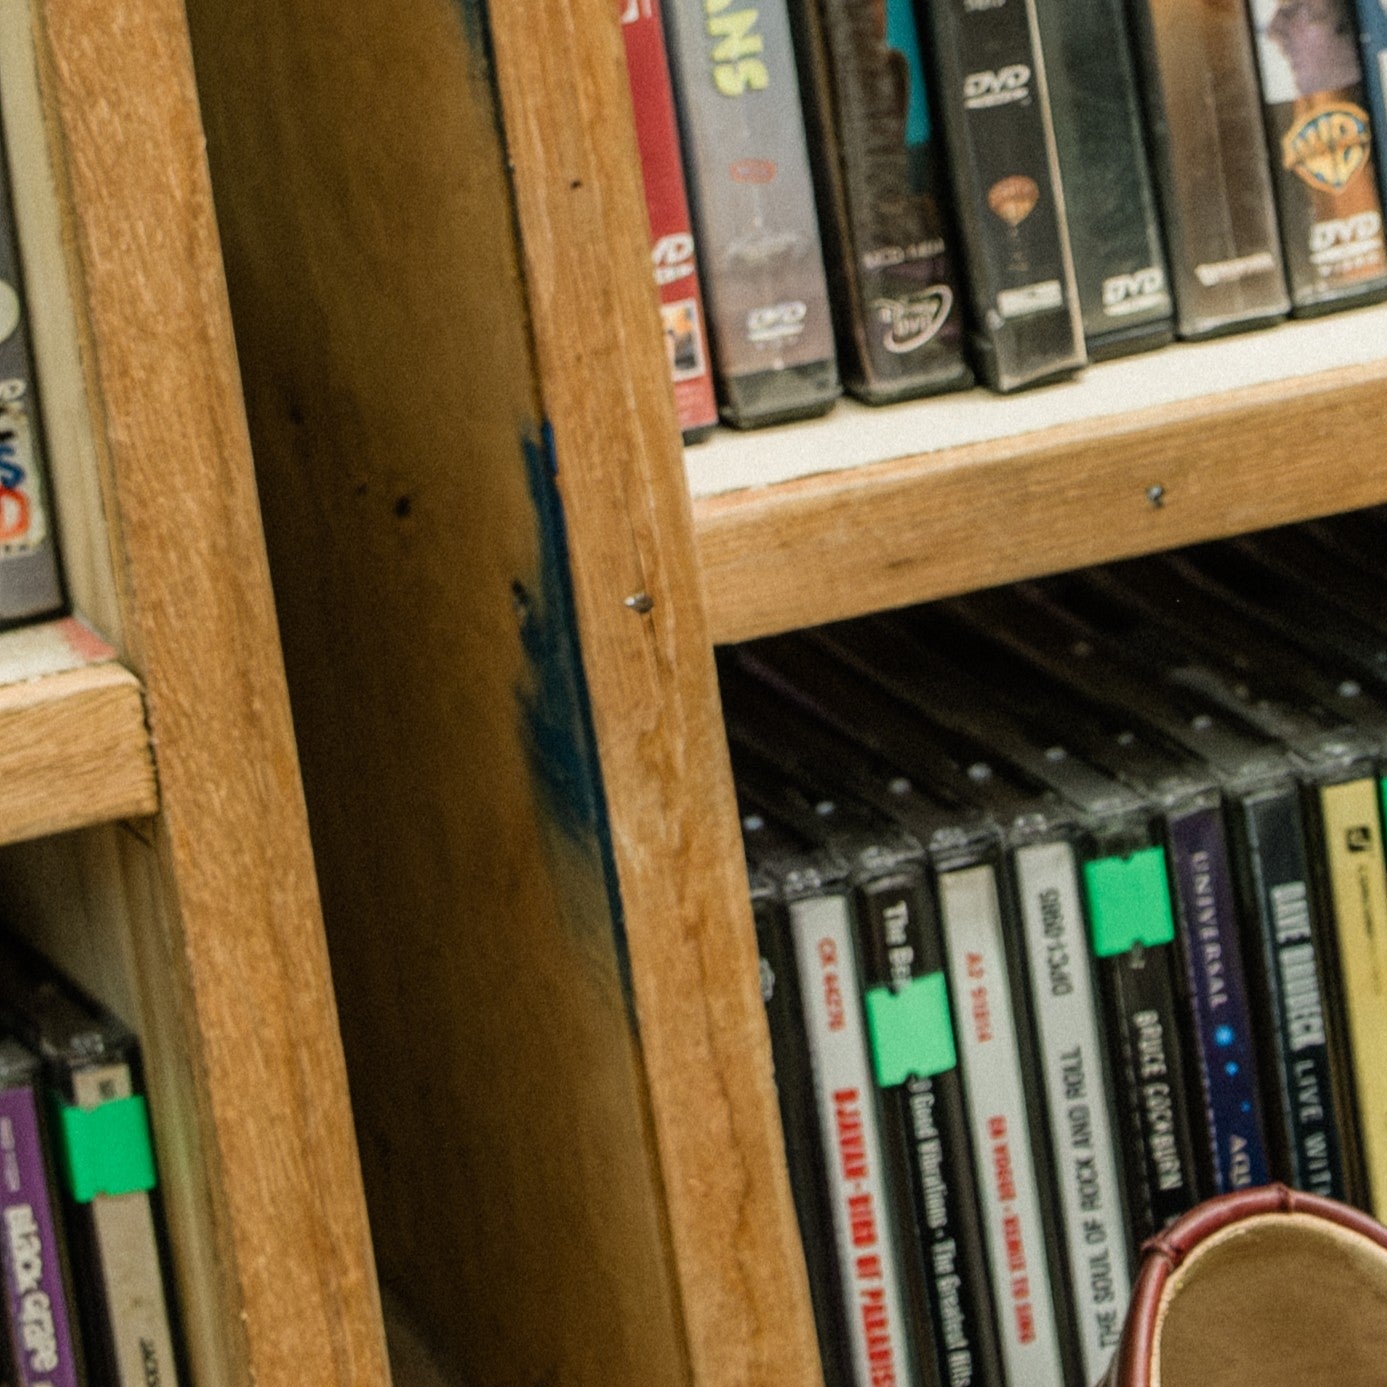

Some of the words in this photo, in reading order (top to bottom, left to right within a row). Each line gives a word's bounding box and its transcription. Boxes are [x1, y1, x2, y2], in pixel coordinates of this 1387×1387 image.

[1310, 212, 1382, 251] DVD
[879, 900, 912, 945] The
[1185, 848, 1231, 1011] UNIVERSAL
[1267, 879, 1313, 943] DAVE
[1291, 1058, 1324, 1124] LIVE
[1129, 1006, 1172, 1079] BRUCE
[1057, 1045, 1088, 1101] ROLL
[907, 1093, 939, 1139] Good
[984, 1112, 1009, 1139] EN
[1065, 1104, 1095, 1150] AND
[1139, 1078, 1190, 1191] COCKBURN
[914, 1138, 955, 1230] Vibrations
[988, 1141, 1018, 1203] VOGUE
[1072, 1155, 1104, 1213] ROCK
[1081, 1217, 1108, 1246] OF
[853, 1252, 884, 1284] OF
[929, 1239, 960, 1275] The
[1085, 1251, 1116, 1306] SOUL
[1006, 1274, 1031, 1301] TO
[934, 1273, 972, 1351] Greatest
[1010, 1302, 1037, 1345] SING
[1093, 1308, 1122, 1351] THE
